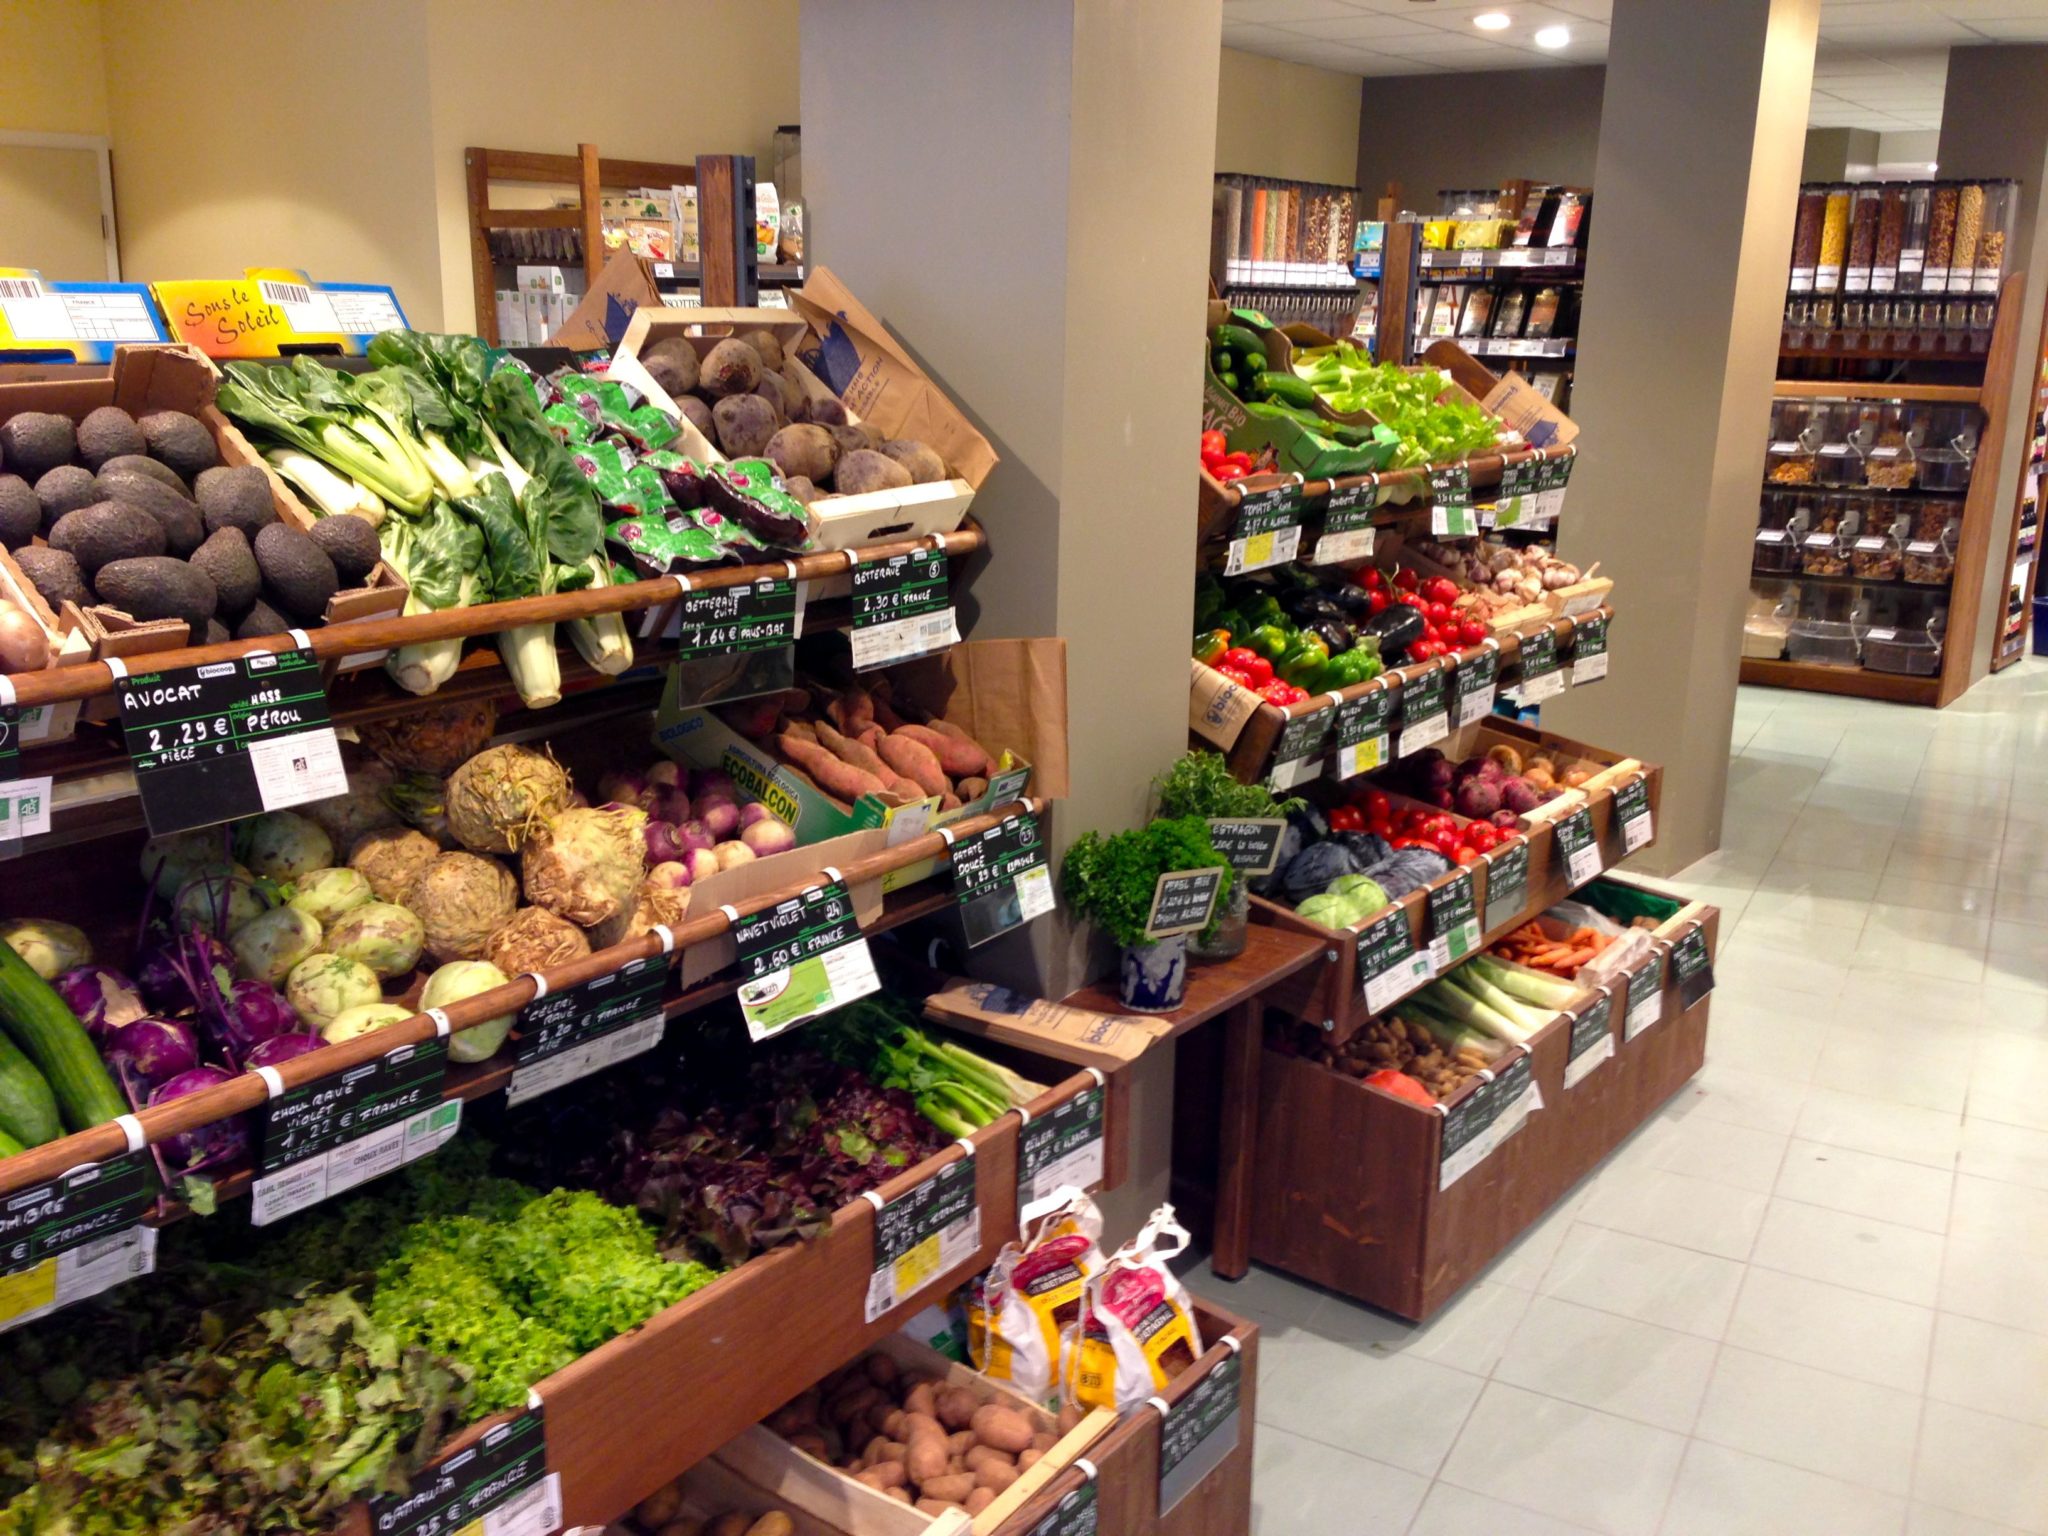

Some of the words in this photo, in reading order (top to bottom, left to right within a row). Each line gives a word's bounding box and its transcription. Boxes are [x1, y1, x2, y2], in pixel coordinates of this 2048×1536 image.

[1243, 501, 1271, 516] TOMATE
[855, 563, 901, 585] BETTERAVE
[685, 595, 740, 613] BETTERAVE
[863, 594, 889, 612] 2,30
[891, 593, 899, 606] €
[903, 588, 932, 604] FRANCE
[691, 627, 725, 648] 1,64
[728, 625, 737, 640] €
[131, 674, 162, 686] Produit
[204, 665, 234, 677] biocoop
[124, 683, 202, 711] AVOCAT
[250, 688, 282, 706] HASS
[148, 720, 208, 752] 2,29
[213, 717, 229, 737] €
[246, 709, 302, 733] PÉROU
[160, 745, 197, 765] PIÈCE
[215, 743, 225, 755] €
[722, 753, 798, 824] ECOBALCON
[1212, 824, 1262, 836] ESTRAGON
[953, 841, 984, 864] PATATE
[958, 855, 985, 877] DOUCE
[992, 864, 999, 878] €
[735, 919, 770, 945] NAVET
[769, 905, 807, 931] VIOLET
[754, 949, 789, 976] 2,60
[790, 942, 802, 957] €
[807, 926, 846, 952] FRANCE
[581, 1014, 592, 1027] €
[597, 997, 643, 1023] FRANCE
[270, 1101, 312, 1123] CHOU
[312, 1081, 356, 1107] RAVE
[280, 1118, 331, 1149] 1,22
[338, 1112, 354, 1128] €
[358, 1089, 420, 1122] FRANCE
[286, 1102, 338, 1129] VIOLET
[10, 1242, 29, 1260] €
[42, 1207, 125, 1249] FRANCE
[446, 1502, 463, 1522] €
[468, 1459, 530, 1510] FRANCE
